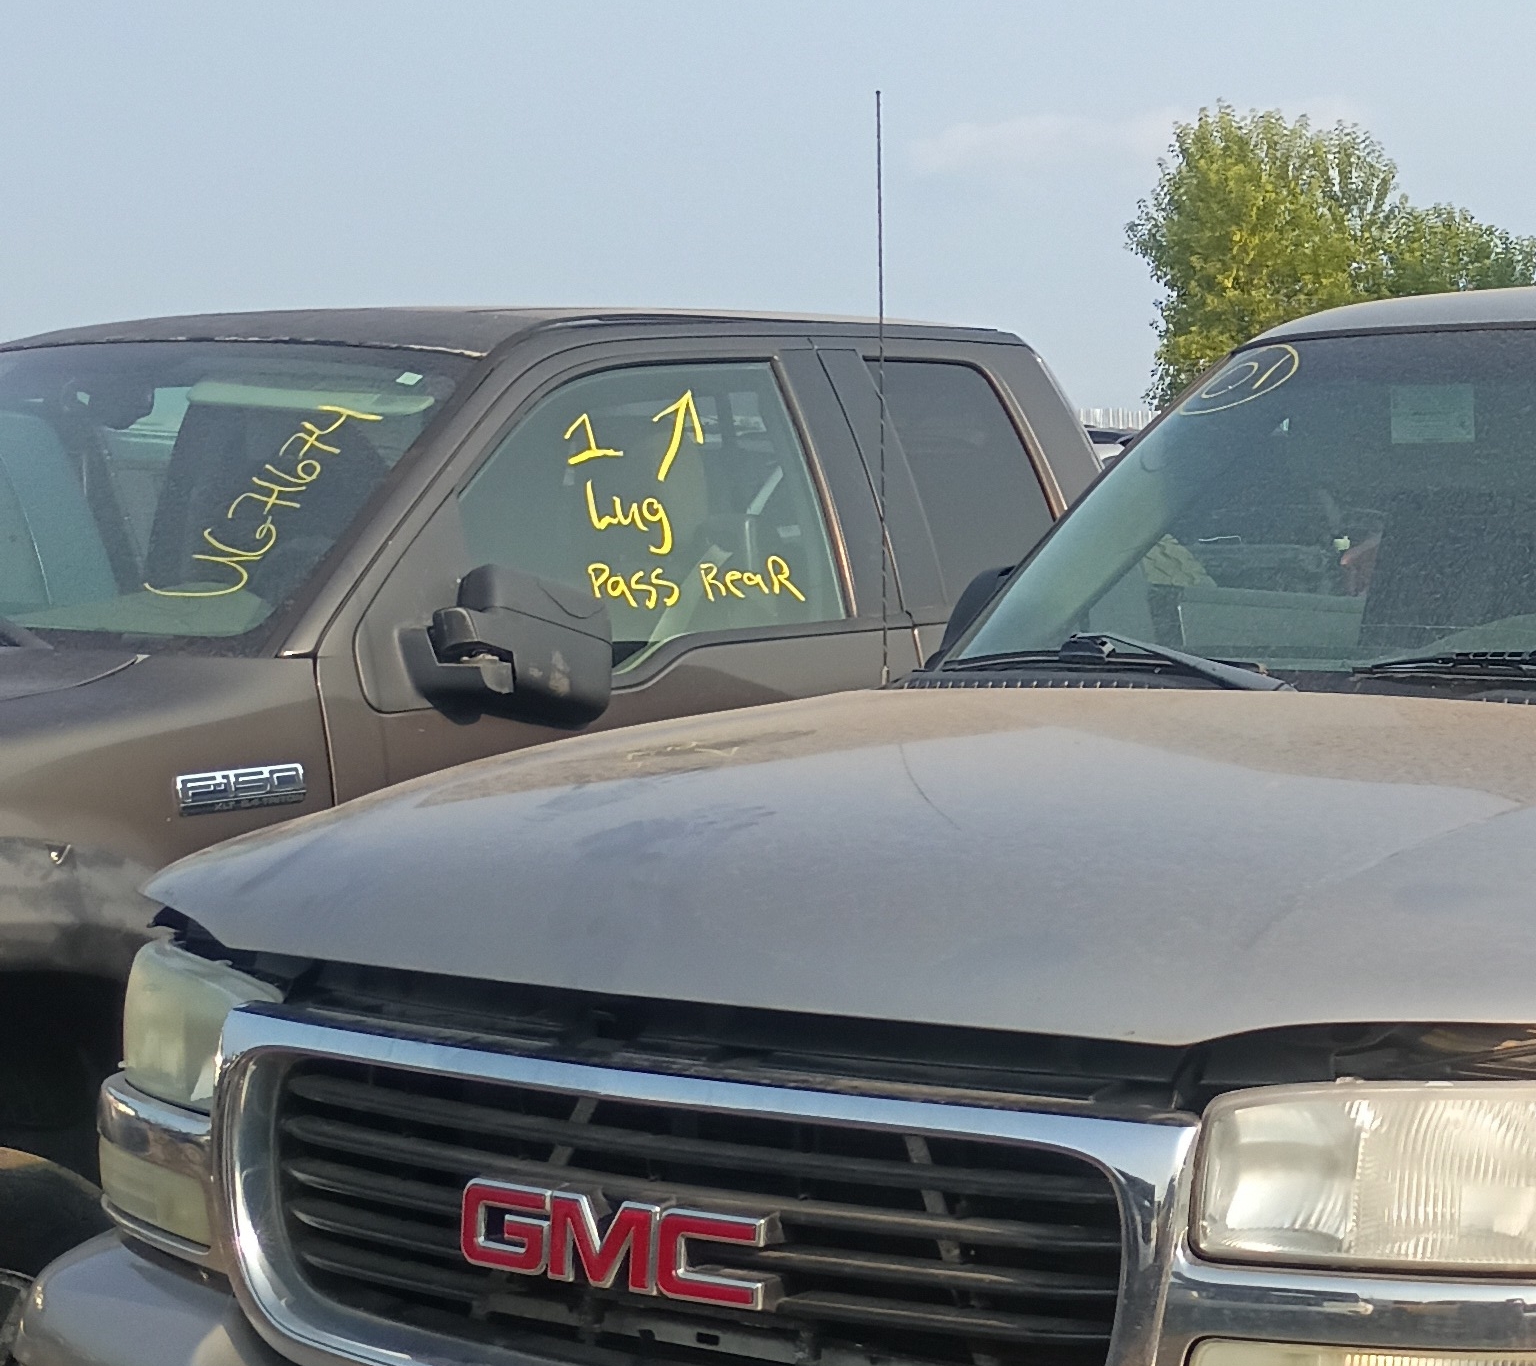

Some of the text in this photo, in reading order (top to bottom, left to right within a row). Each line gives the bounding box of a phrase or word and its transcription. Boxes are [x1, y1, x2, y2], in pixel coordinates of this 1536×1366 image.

[564, 413, 624, 465] 1
[177, 763, 304, 803] F-150
[460, 1176, 770, 1311] GMC
